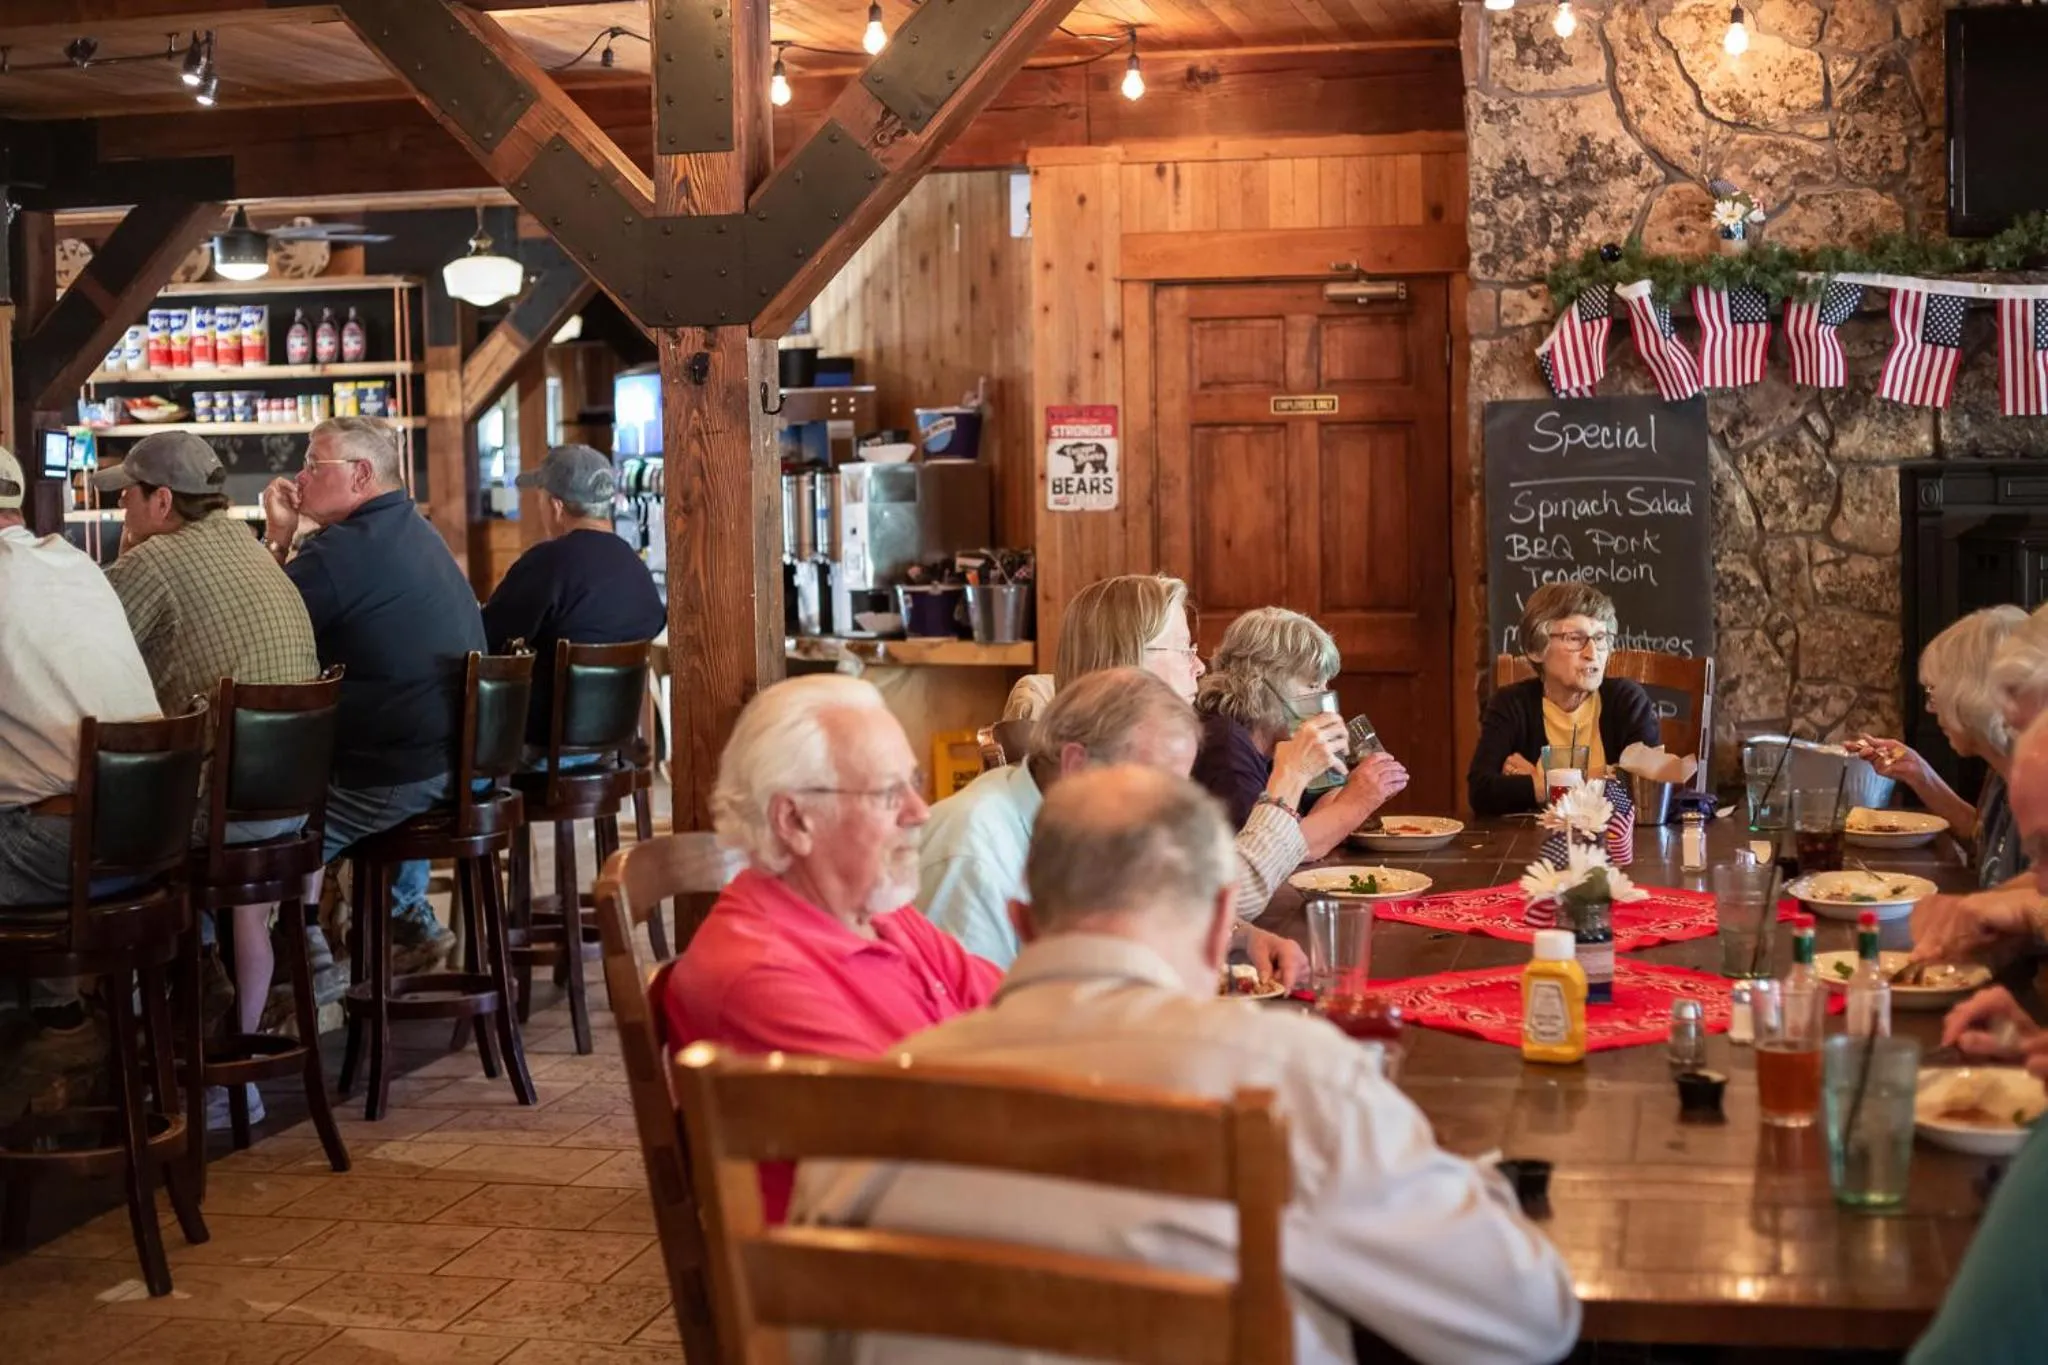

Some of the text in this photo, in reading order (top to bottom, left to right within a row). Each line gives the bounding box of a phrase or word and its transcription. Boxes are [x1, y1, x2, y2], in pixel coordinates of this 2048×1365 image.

[1528, 410, 1658, 457] Special
[1052, 477, 1114, 495] BEARS
[1509, 486, 1693, 532] Spinach Salad
[1585, 528, 1662, 556] Pork
[1522, 558, 1659, 589] Tenderloin
